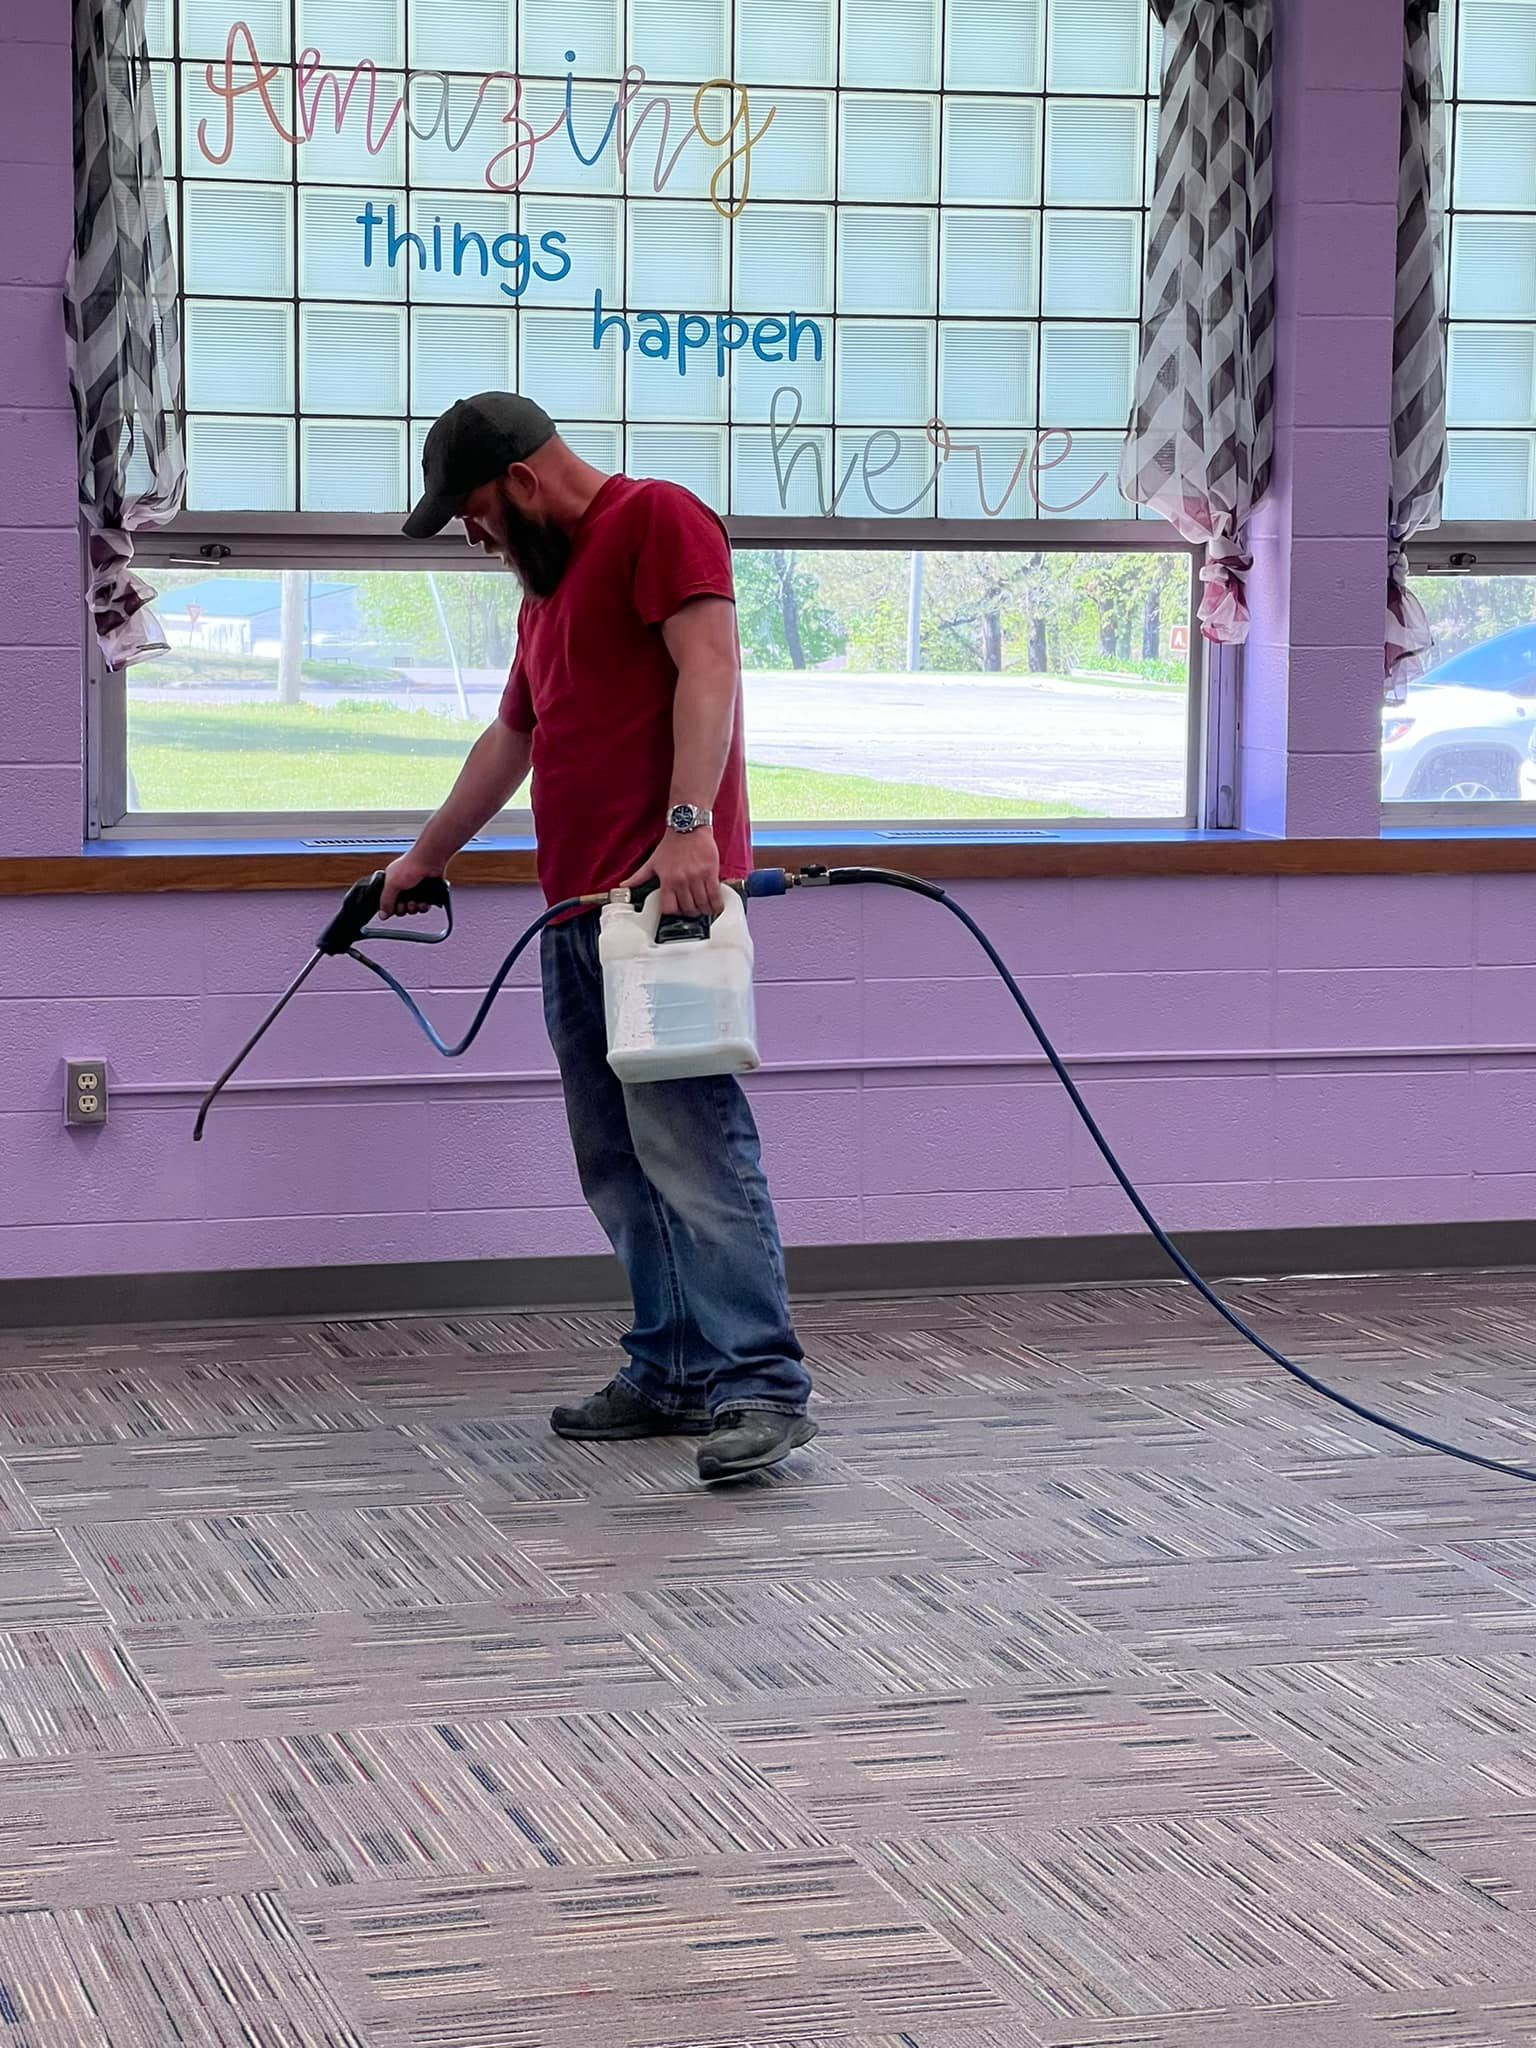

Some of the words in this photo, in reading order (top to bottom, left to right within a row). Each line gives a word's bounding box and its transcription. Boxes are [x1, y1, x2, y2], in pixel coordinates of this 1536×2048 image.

[198, 21, 776, 218] Amazing
[356, 202, 571, 297] things
[593, 289, 823, 377] happen
[770, 386, 1108, 517] here
